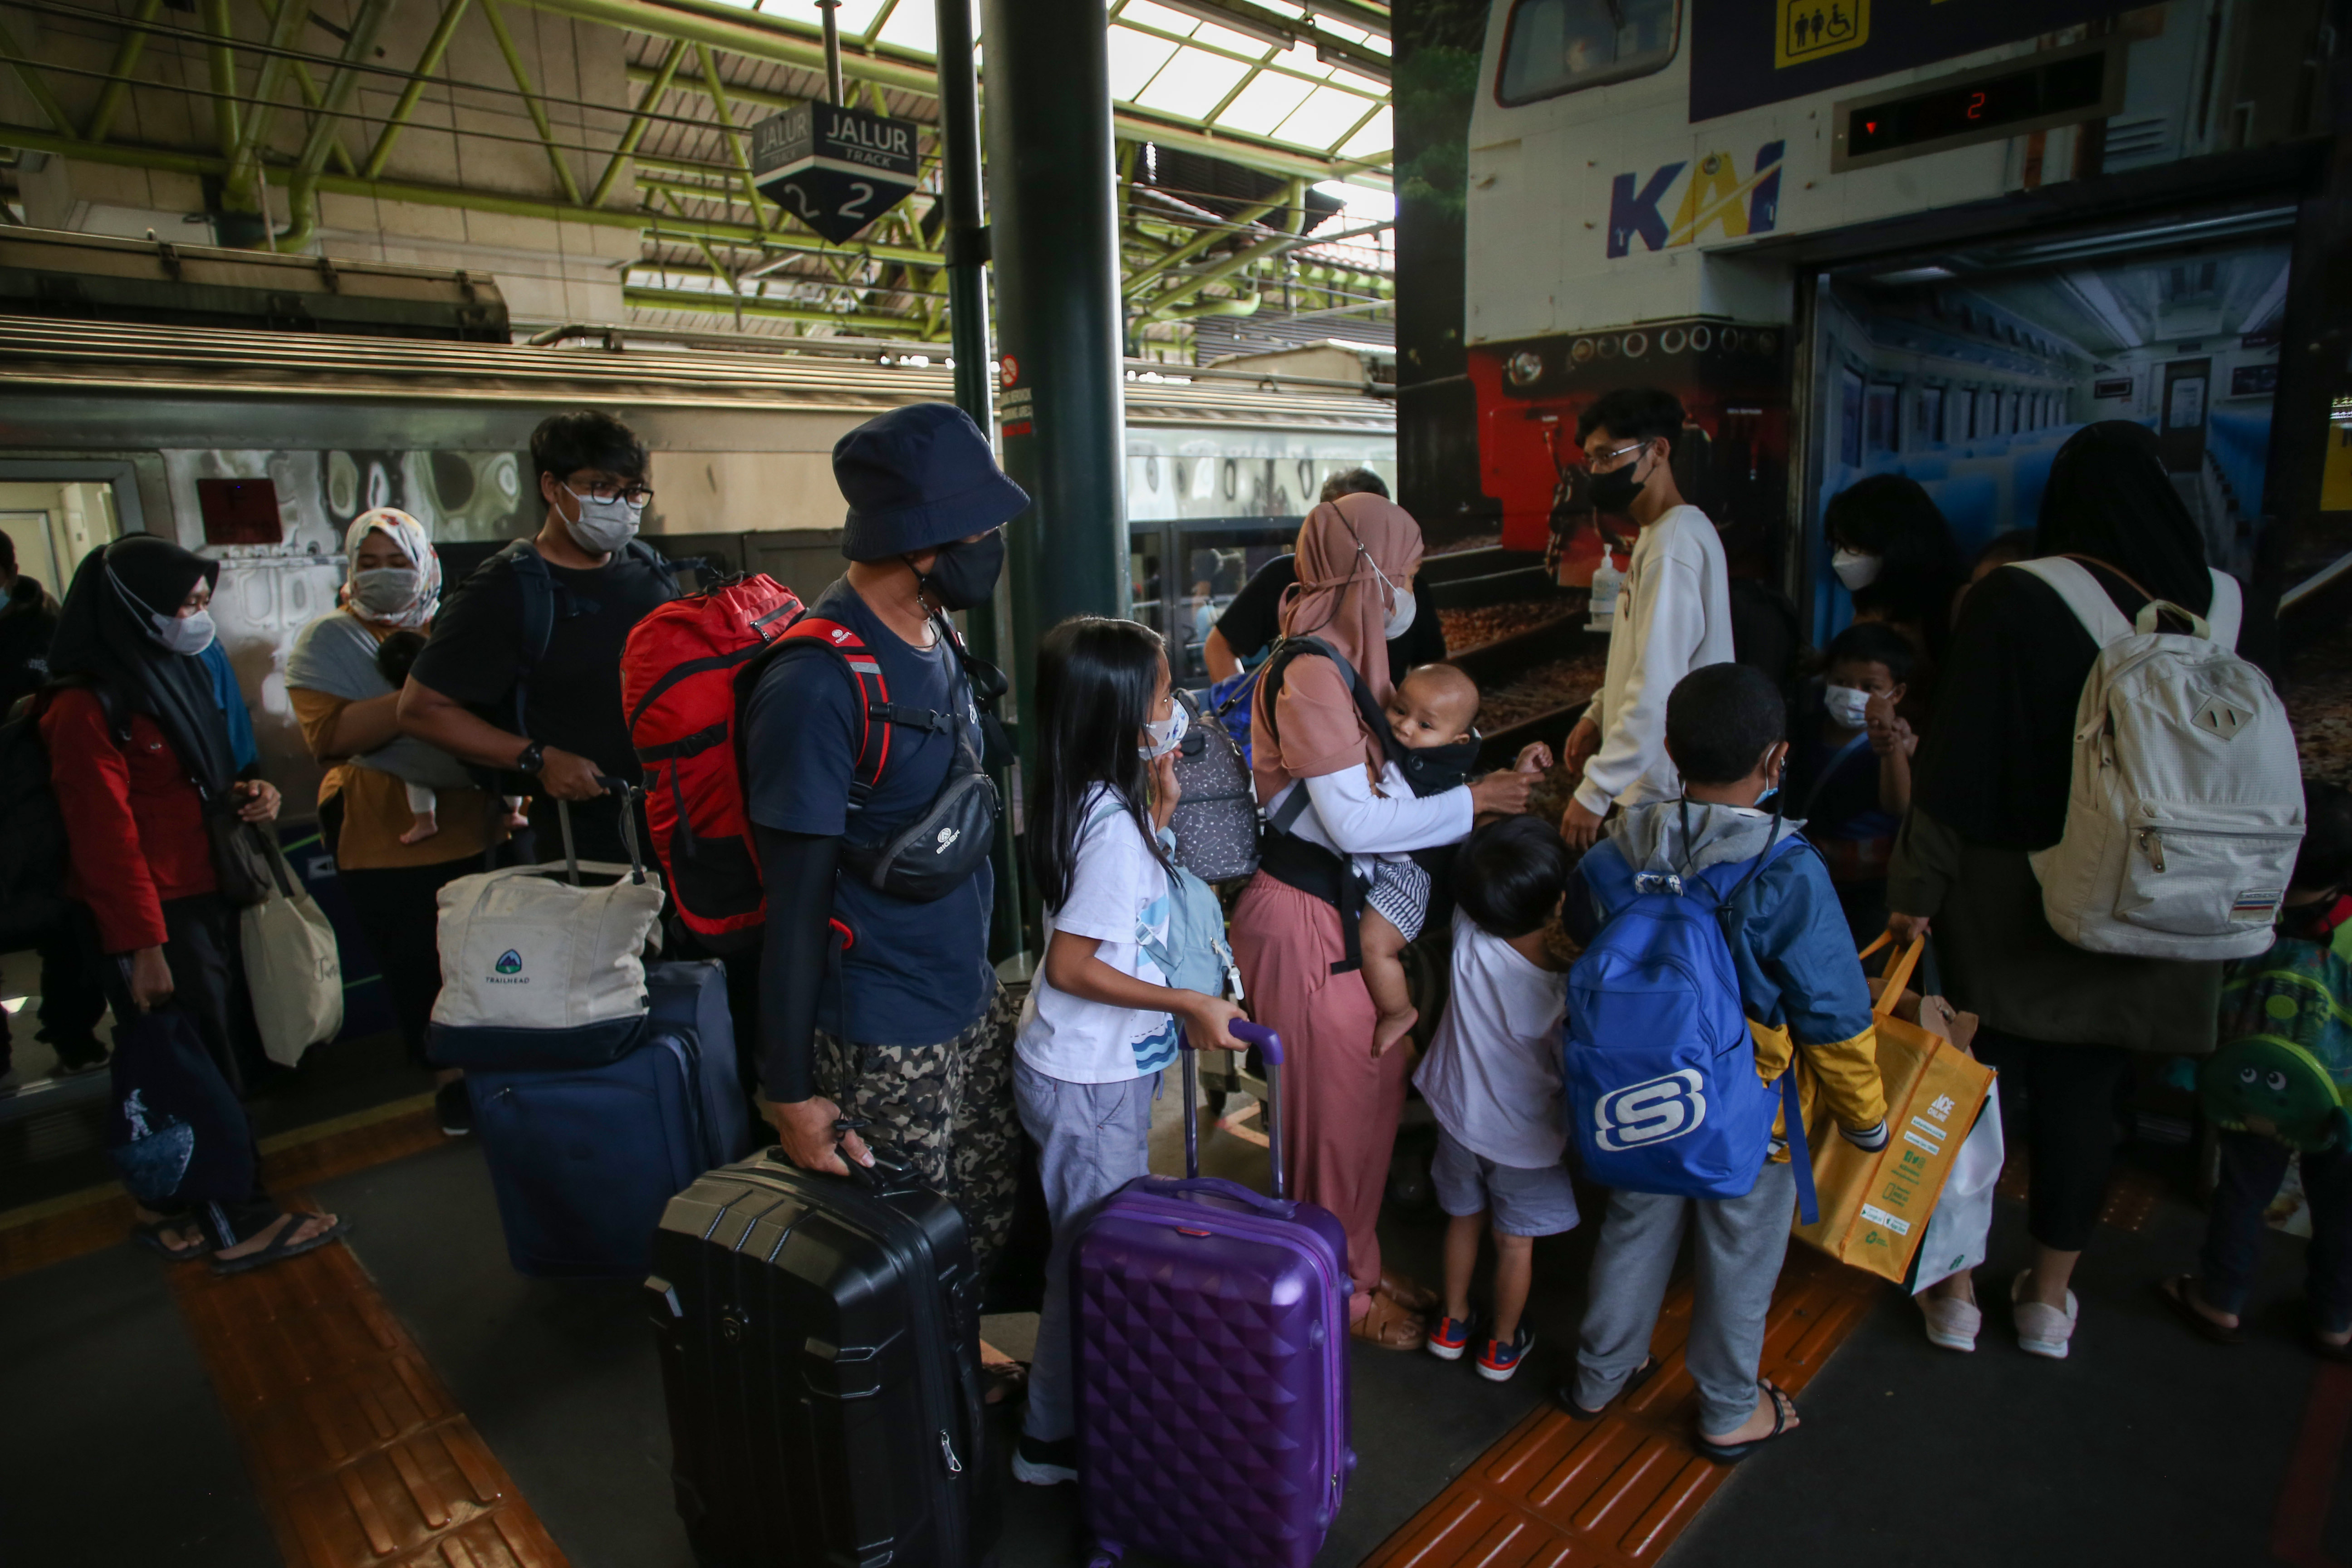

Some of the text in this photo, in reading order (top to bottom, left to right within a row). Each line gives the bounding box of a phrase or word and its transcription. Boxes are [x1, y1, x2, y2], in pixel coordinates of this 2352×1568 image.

[1967, 93, 1985, 119] 2
[761, 113, 808, 152] JALUR
[826, 113, 909, 153] JALUR
[846, 148, 891, 168] TRACK
[784, 183, 819, 218] 2
[837, 182, 874, 219] 2
[1607, 141, 1785, 259] KAI
[936, 829, 960, 854] EIGER
[1927, 1107, 1948, 1122] ONLINE
[1931, 1093, 1955, 1116] ACE
